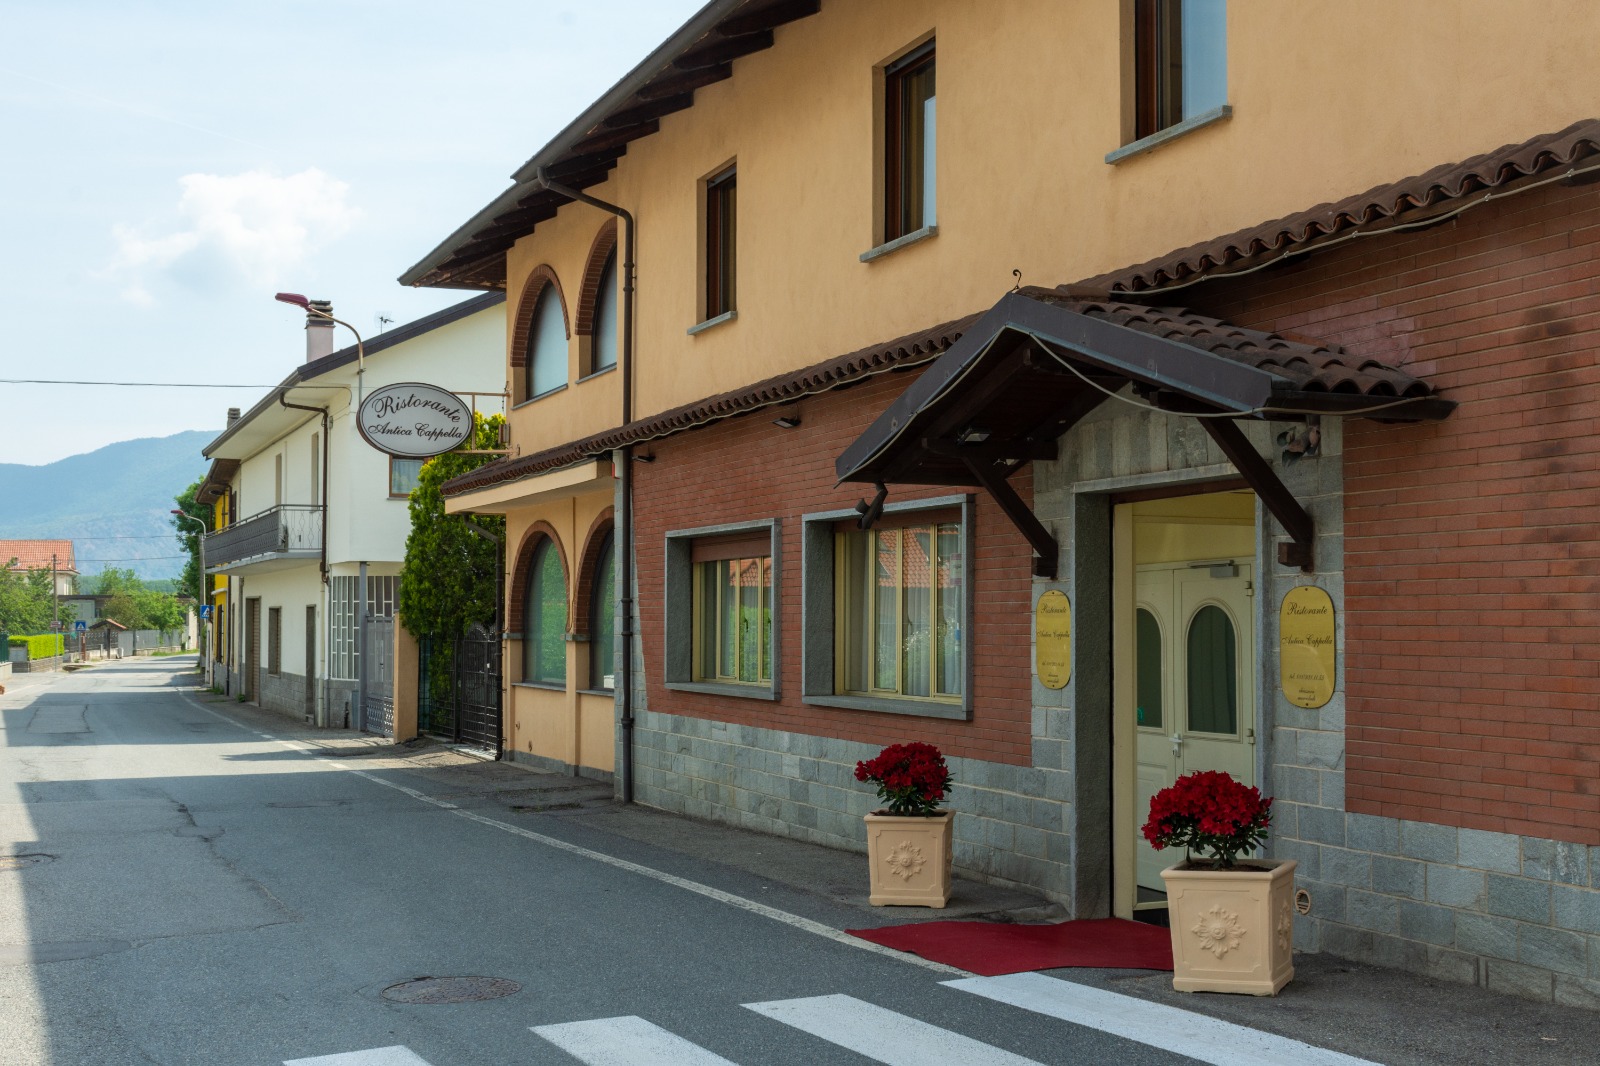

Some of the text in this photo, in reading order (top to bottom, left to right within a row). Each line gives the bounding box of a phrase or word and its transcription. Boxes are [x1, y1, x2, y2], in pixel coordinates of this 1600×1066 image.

[371, 393, 461, 422] Ristorante
[368, 421, 462, 441] Antica Cappella
[1286, 601, 1328, 615] Ristorante
[1281, 633, 1333, 648] Antica Cappella
